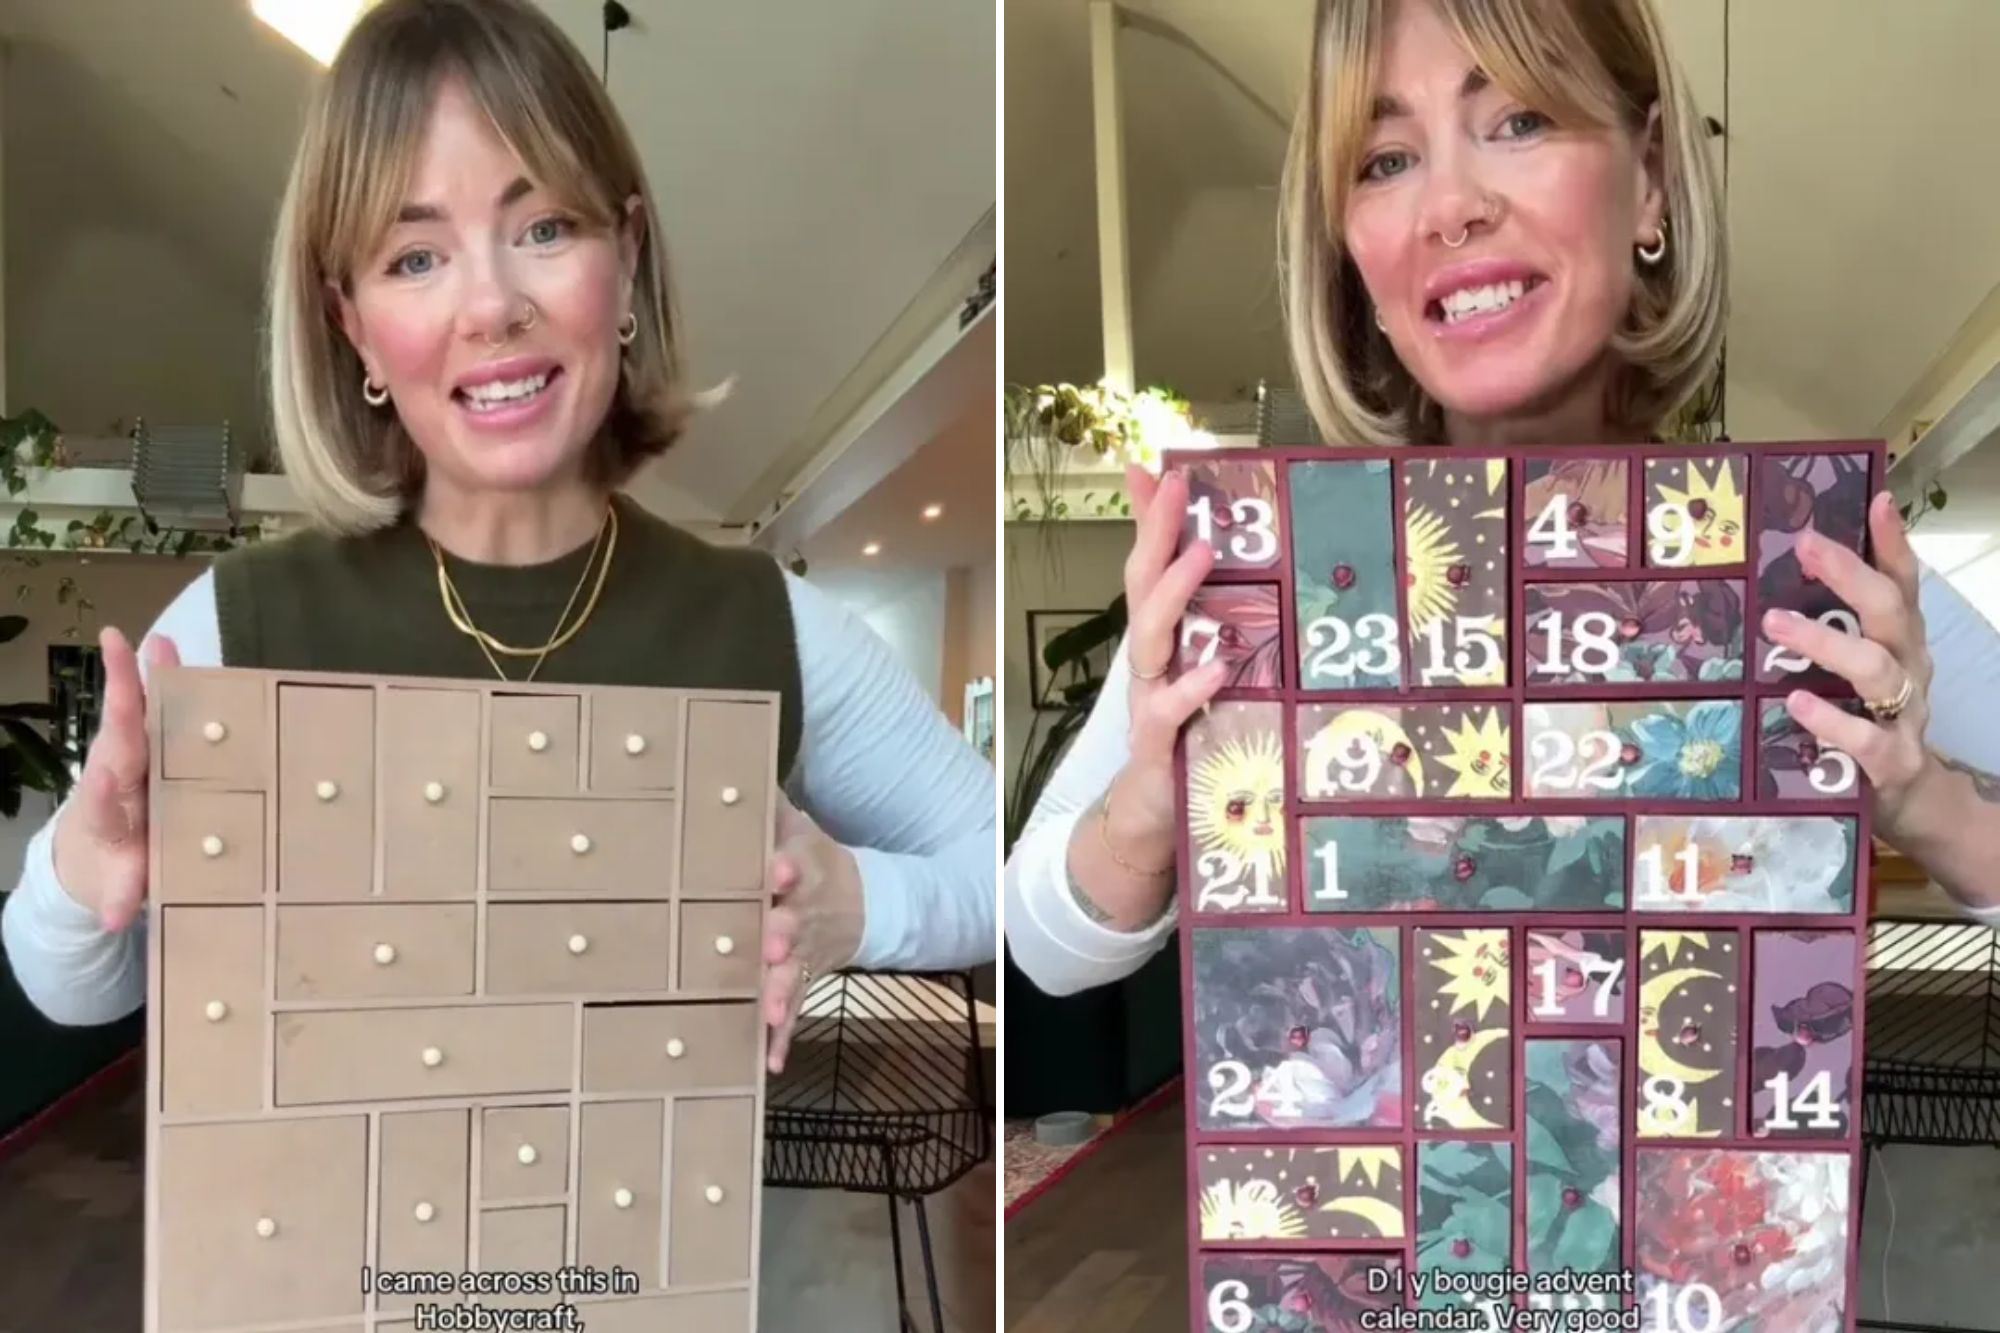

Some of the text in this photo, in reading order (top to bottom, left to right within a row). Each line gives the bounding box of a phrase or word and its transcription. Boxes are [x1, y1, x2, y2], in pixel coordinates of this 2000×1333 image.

[1187, 496, 1276, 561] 13
[1527, 494, 1577, 558] 4
[1649, 502, 1695, 565] 9
[1307, 613, 1400, 677] 23
[1420, 615, 1499, 678] 15
[1530, 611, 1620, 674] 18
[1531, 731, 1624, 789] 22
[1198, 850, 1278, 911] 21
[1314, 840, 1347, 898] 1
[1638, 843, 1706, 902] 11
[1532, 958, 1624, 1016] 17
[1208, 1060, 1302, 1116] 24
[1643, 1074, 1688, 1131] 8
[1764, 1071, 1840, 1129] 14
[1209, 1280, 1252, 1333] 6
[1645, 1280, 1721, 1333] 10
